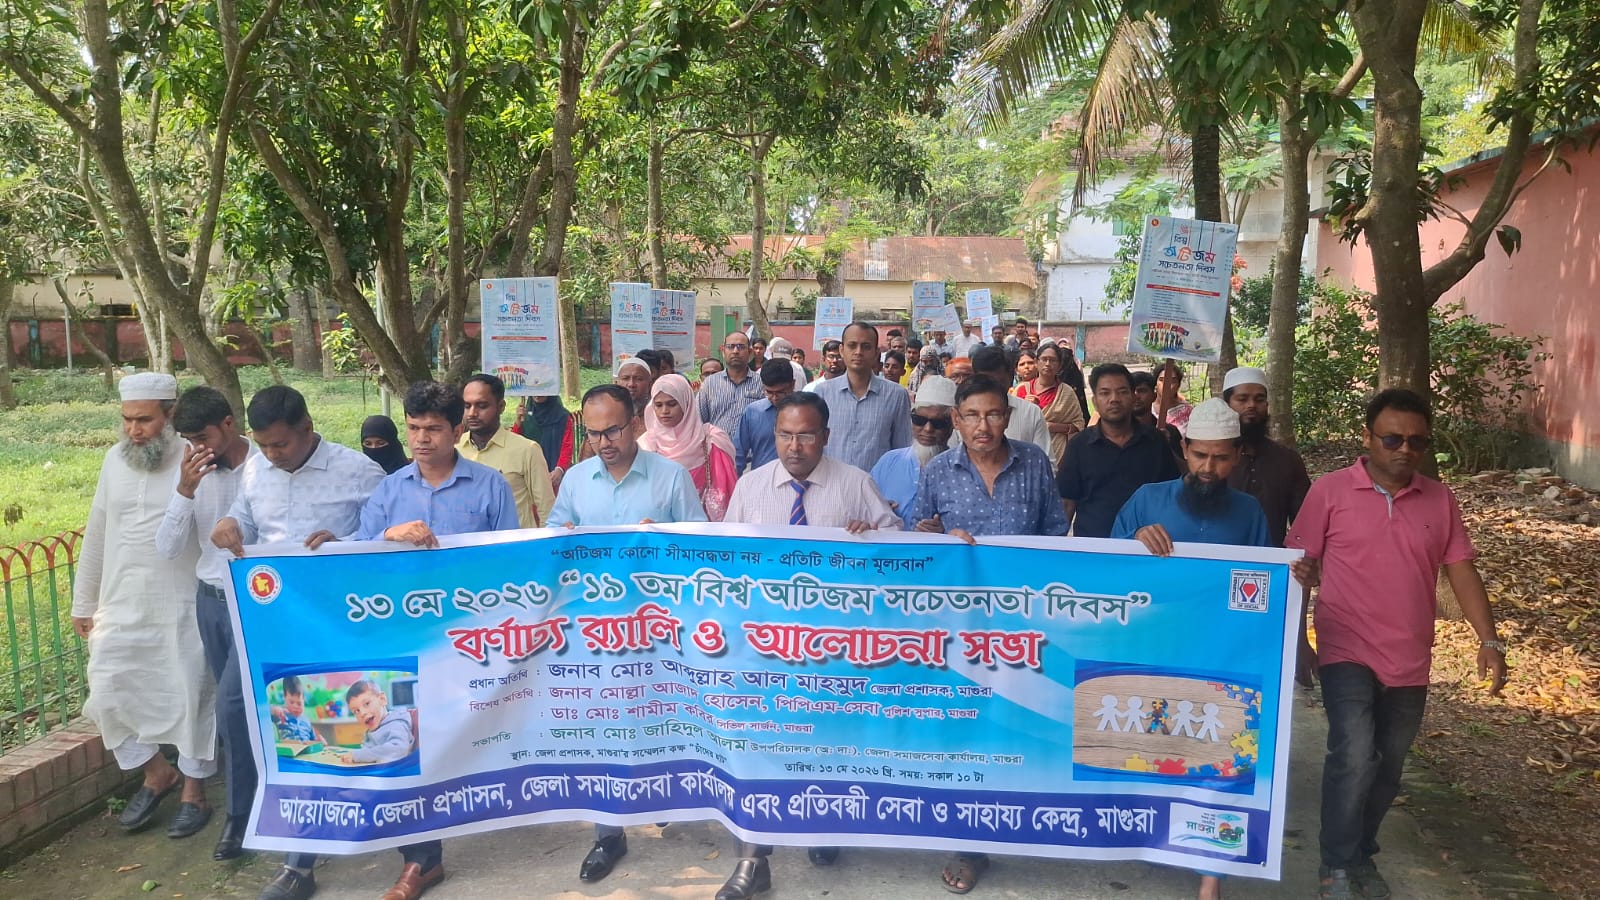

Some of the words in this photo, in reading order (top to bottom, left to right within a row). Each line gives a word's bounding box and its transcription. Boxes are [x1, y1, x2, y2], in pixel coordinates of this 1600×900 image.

[618, 545, 660, 561] কোনো
[665, 544, 736, 565] সীমাবদ্ধতা
[741, 551, 763, 565] নয়
[779, 549, 824, 567] প্রতিটি
[829, 553, 868, 571] জীবন
[347, 594, 392, 621] ১৩
[404, 589, 446, 616] মে
[455, 582, 550, 614] ২০২৬
[633, 572, 686, 603] তম
[694, 568, 752, 606] বিশ্ব
[760, 572, 875, 613] অটিজম
[885, 585, 1036, 618] সচেতনতা
[1044, 583, 1150, 624] দিবস”
[447, 615, 569, 663] বর্ণাঢ্য
[694, 620, 725, 655] ও
[744, 621, 948, 667] আলোচনা
[959, 630, 1044, 668] সভা
[468, 677, 494, 690] প্রধান
[547, 662, 602, 679] জনাব
[741, 670, 789, 689] আল
[794, 674, 869, 697] মাহমুদ
[870, 684, 901, 696] জেলা
[904, 685, 953, 698] প্রশাসক,
[957, 685, 993, 698] মাগুরা
[548, 686, 593, 700] জনাব
[599, 684, 648, 701] মোল্লা
[651, 681, 698, 698] আজাদ
[703, 694, 768, 713] হোসেন,
[948, 708, 978, 719] মাগুরা
[624, 700, 679, 720] শামীম
[550, 727, 597, 741] জনাব
[642, 719, 703, 738] জাহিদুল
[706, 731, 748, 751] আলম
[836, 765, 849, 774] মে
[851, 766, 880, 776] ২০২৬
[373, 796, 427, 827] জেলা
[433, 782, 513, 815] প্রশাসন,
[521, 773, 571, 802] জেলা
[574, 770, 674, 802] সমাজসেবা
[677, 767, 735, 811] কার্যালয়
[741, 792, 783, 822] এবং
[787, 784, 870, 821] প্রতিবন্ধী
[876, 795, 925, 824] সেবা
[931, 801, 949, 824] ও
[954, 801, 1025, 832] সাহায্য
[1032, 806, 1089, 839] কেন্দ্র,
[1095, 804, 1158, 835] মাগুরা
